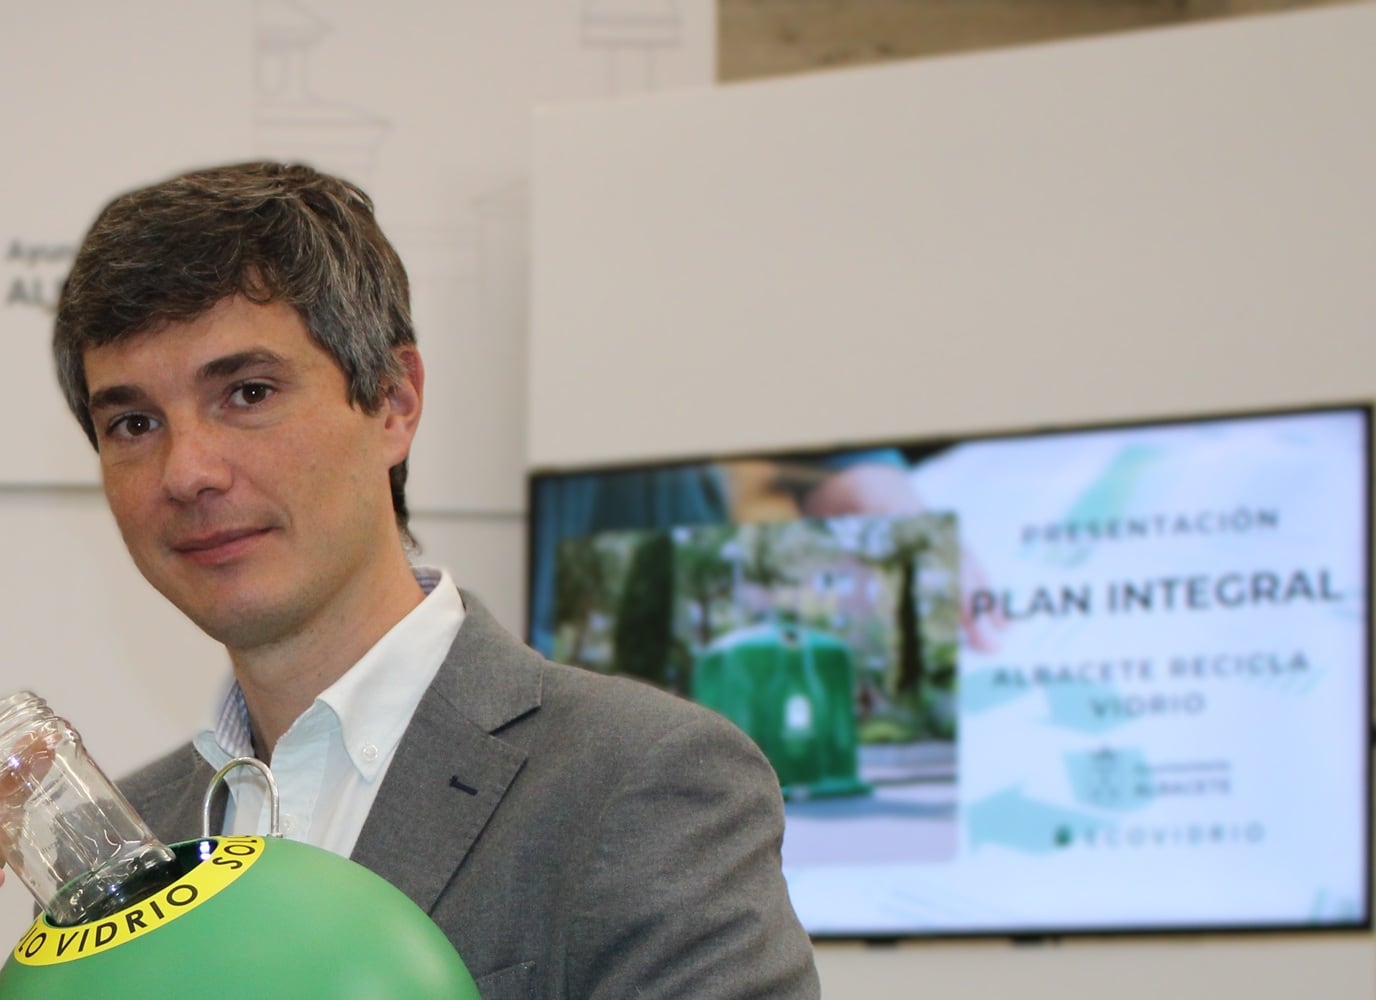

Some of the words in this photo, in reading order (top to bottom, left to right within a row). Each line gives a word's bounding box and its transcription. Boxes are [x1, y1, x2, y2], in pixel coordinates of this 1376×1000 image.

[1021, 506, 1279, 545] PRESENTACIÓN
[970, 581, 1091, 621] PLAN
[1108, 567, 1344, 614] INTEGRAL
[991, 658, 1152, 688] ALBACETE
[1170, 651, 1310, 679] RECICLA
[1090, 692, 1206, 718] VIDRIO
[56, 883, 199, 957] VIDRIO
